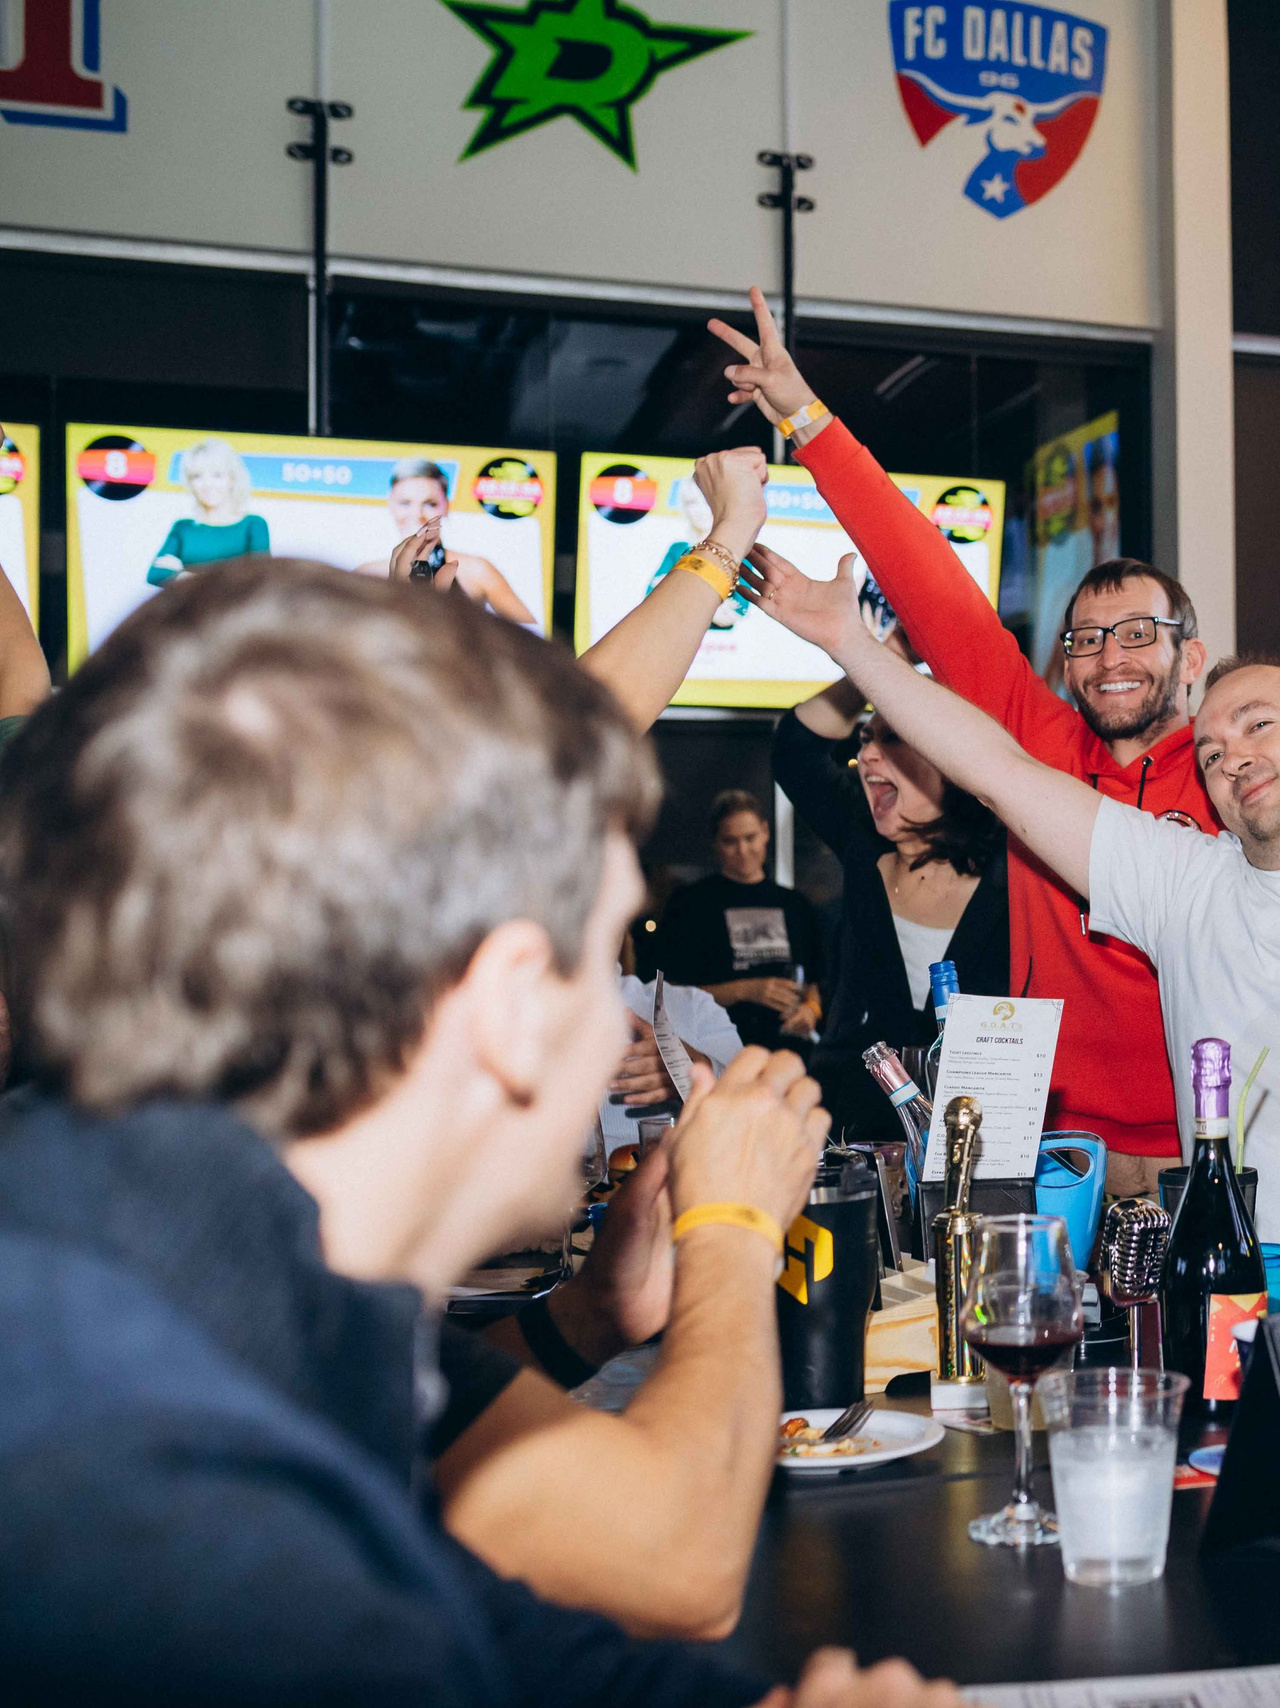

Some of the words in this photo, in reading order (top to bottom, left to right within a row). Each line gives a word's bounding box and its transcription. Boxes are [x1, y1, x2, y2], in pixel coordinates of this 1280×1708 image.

[903, 5, 947, 61] FC
[962, 6, 1094, 80] DALLAS
[104, 451, 128, 479] 8
[282, 462, 353, 486] 50+50
[614, 477, 633, 504] 8
[975, 1036, 994, 1044] CRAFT
[994, 1036, 1024, 1045] COCKTAILS
